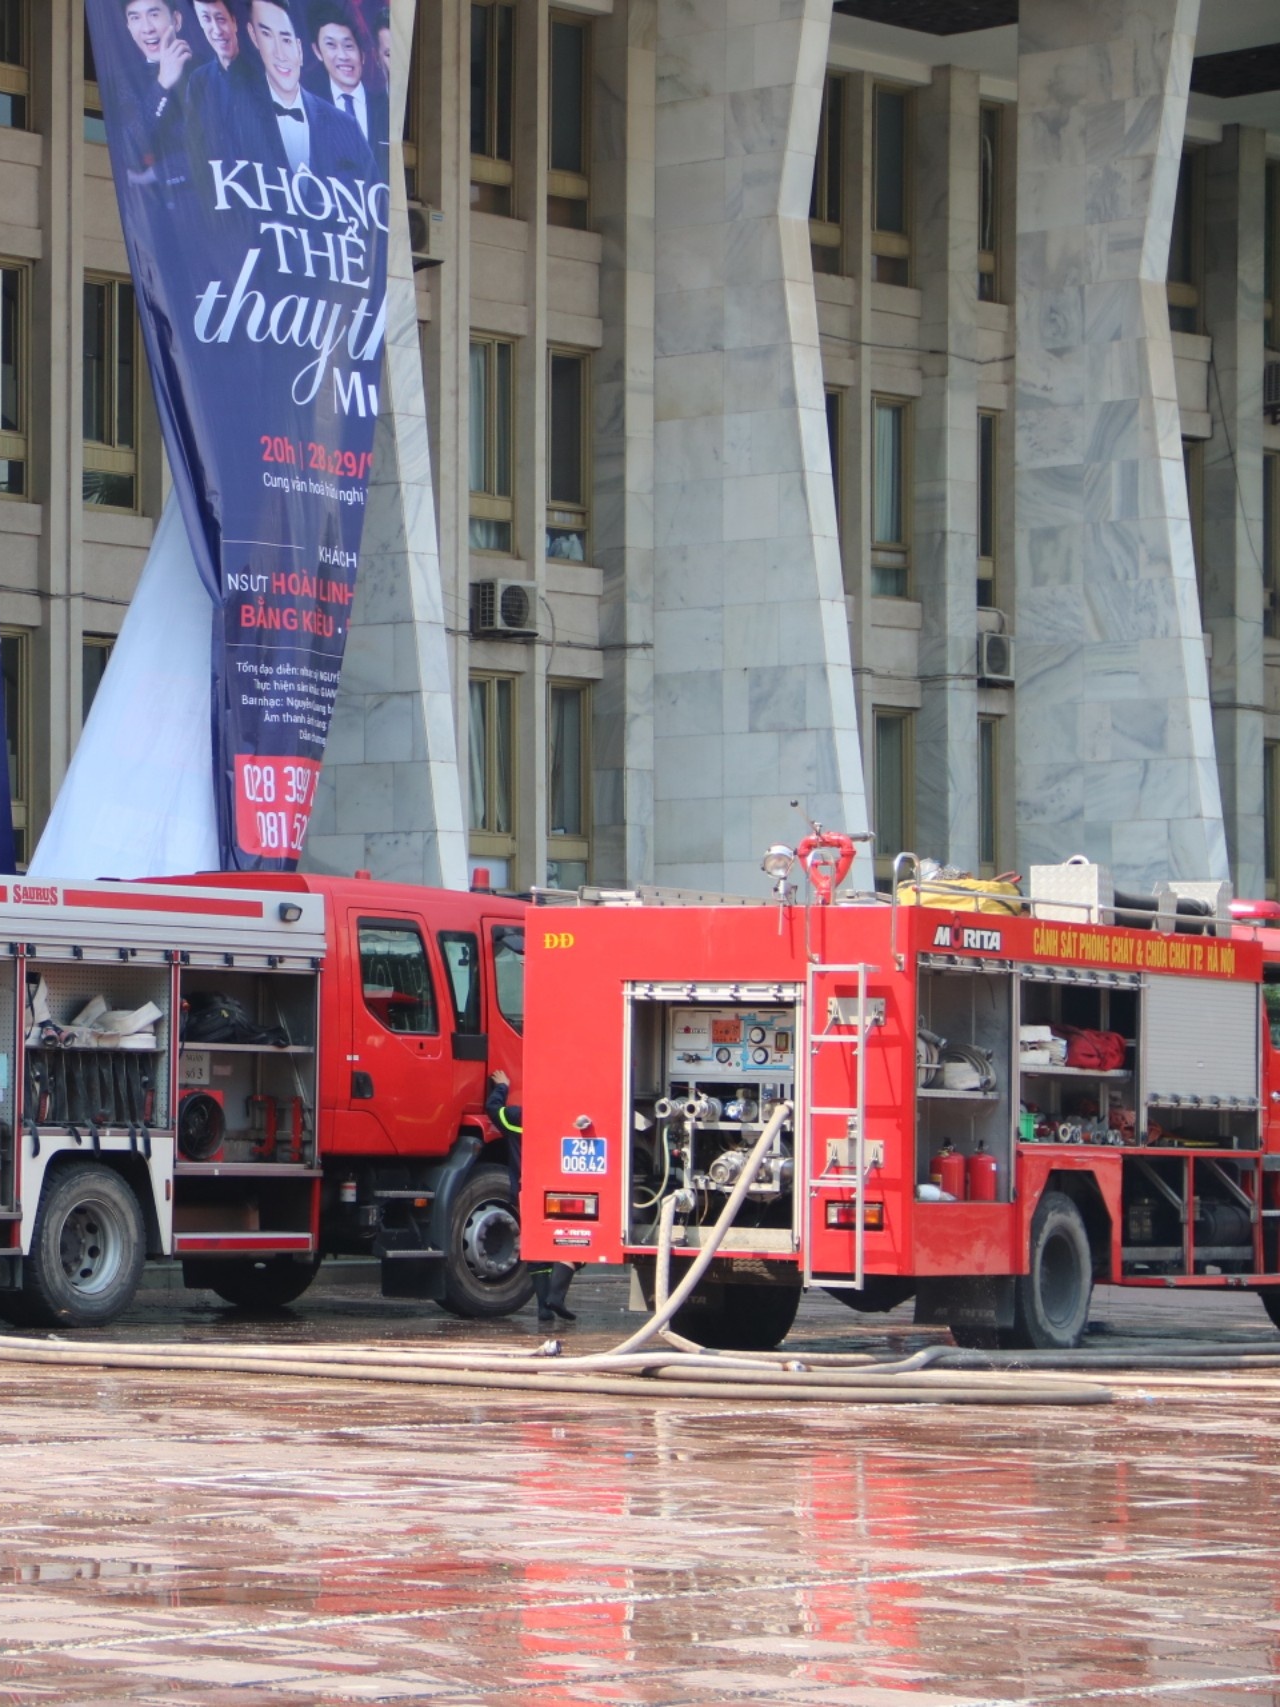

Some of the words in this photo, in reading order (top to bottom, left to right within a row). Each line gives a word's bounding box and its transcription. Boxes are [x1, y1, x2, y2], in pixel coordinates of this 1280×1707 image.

[260, 218, 370, 289] THỂ
[194, 248, 346, 405] thay
[260, 435, 296, 464] 20h
[263, 472, 290, 492] Cung
[340, 486, 364, 505] nghị
[319, 546, 357, 568] KHÁCH
[272, 568, 317, 599] HOÀI
[244, 764, 275, 802] 028
[256, 812, 288, 848] 081
[13, 884, 58, 906] SAURUS
[933, 916, 1001, 951] MORITA
[1033, 921, 1058, 957] CẢNH
[1060, 925, 1078, 958] SÁT
[1080, 928, 1110, 962] PHÒNG
[1112, 930, 1134, 964] CHÁY
[1136, 939, 1144, 966] &
[1169, 936, 1192, 970] CHÁY
[1208, 941, 1218, 972] HÀ
[563, 1156, 605, 1172] 006.42
[572, 1140, 596, 1156] 29A
